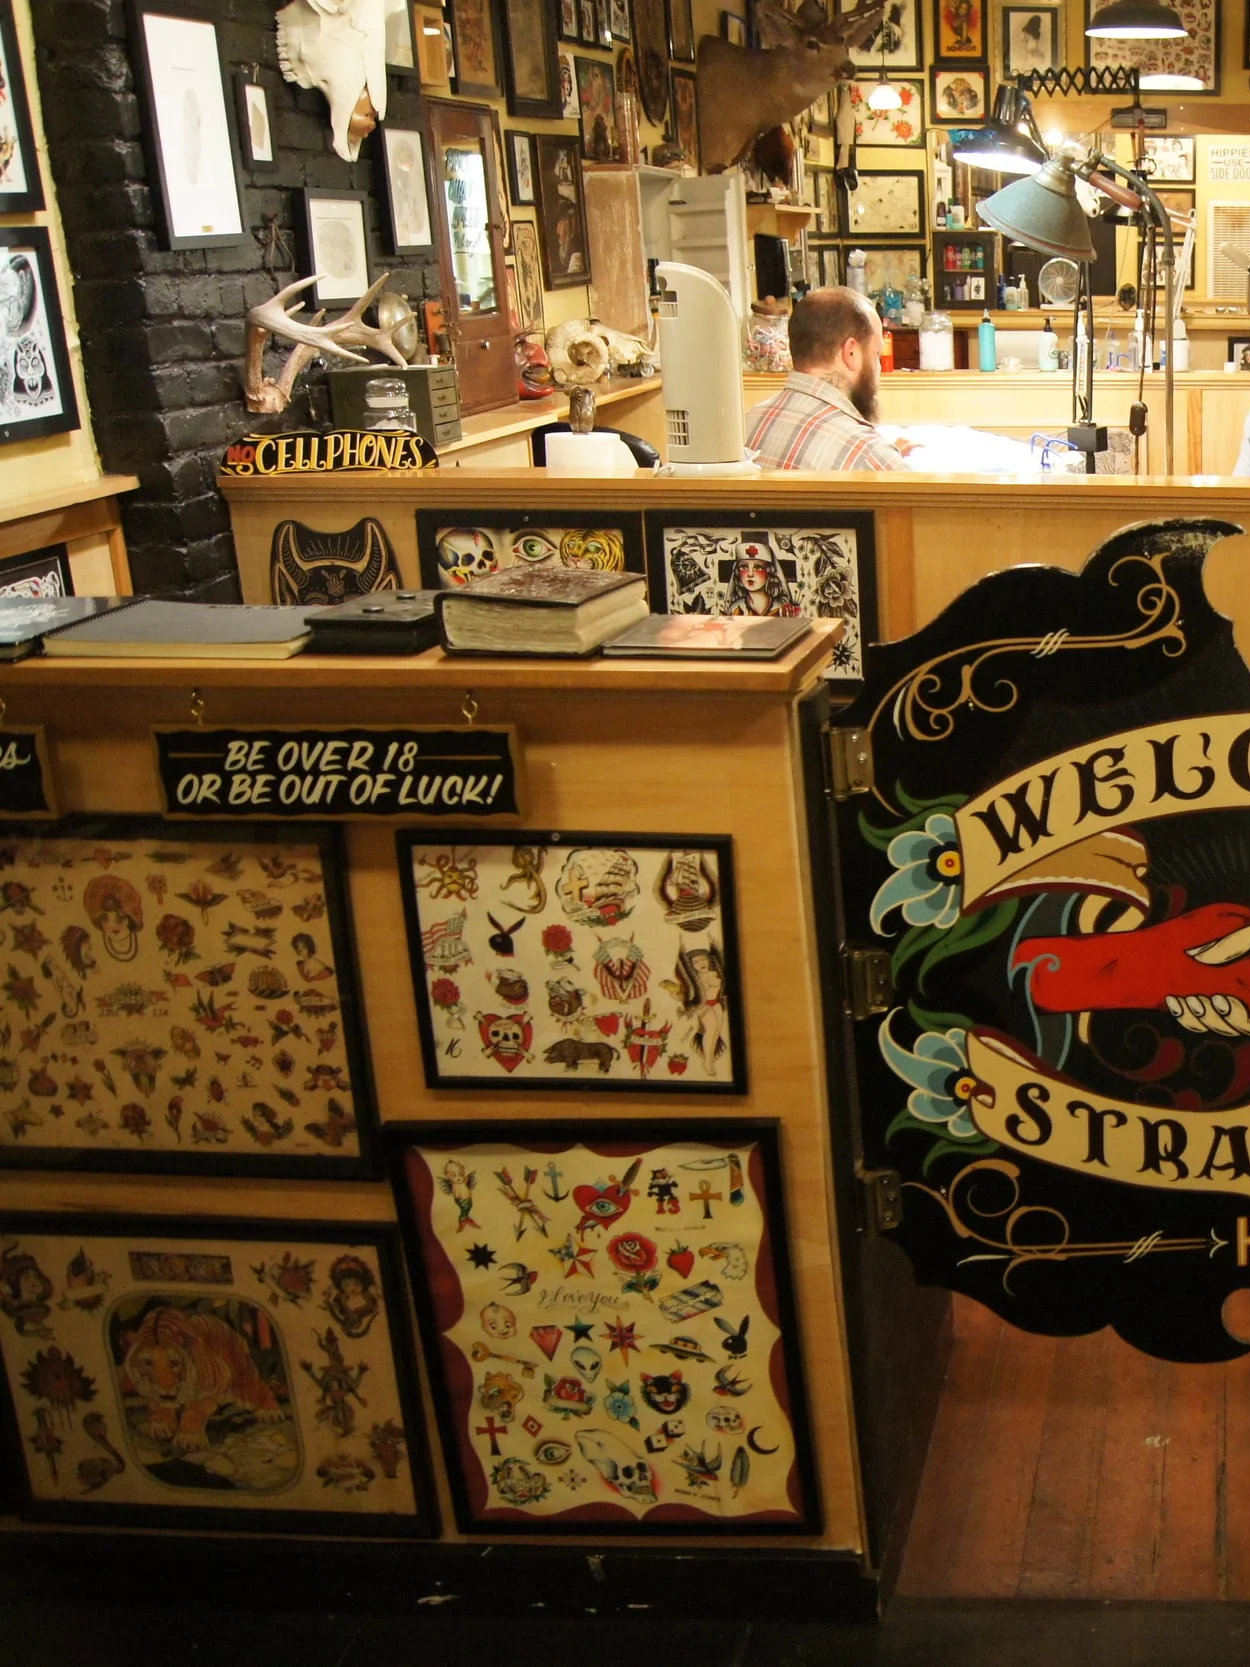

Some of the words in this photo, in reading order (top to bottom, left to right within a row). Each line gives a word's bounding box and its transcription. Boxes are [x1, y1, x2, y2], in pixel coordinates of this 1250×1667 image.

[1211, 168, 1230, 180] SIDE
[1224, 159, 1244, 167] USE
[227, 445, 256, 464] NO
[255, 432, 424, 474] CELLPHONES
[224, 740, 273, 771] BE
[277, 741, 374, 771] OVER
[383, 741, 418, 773] 18
[176, 773, 222, 805] OR
[228, 774, 273, 805] BE
[279, 774, 347, 805] OUT
[349, 774, 397, 805] OF
[399, 774, 503, 806] LUCK!
